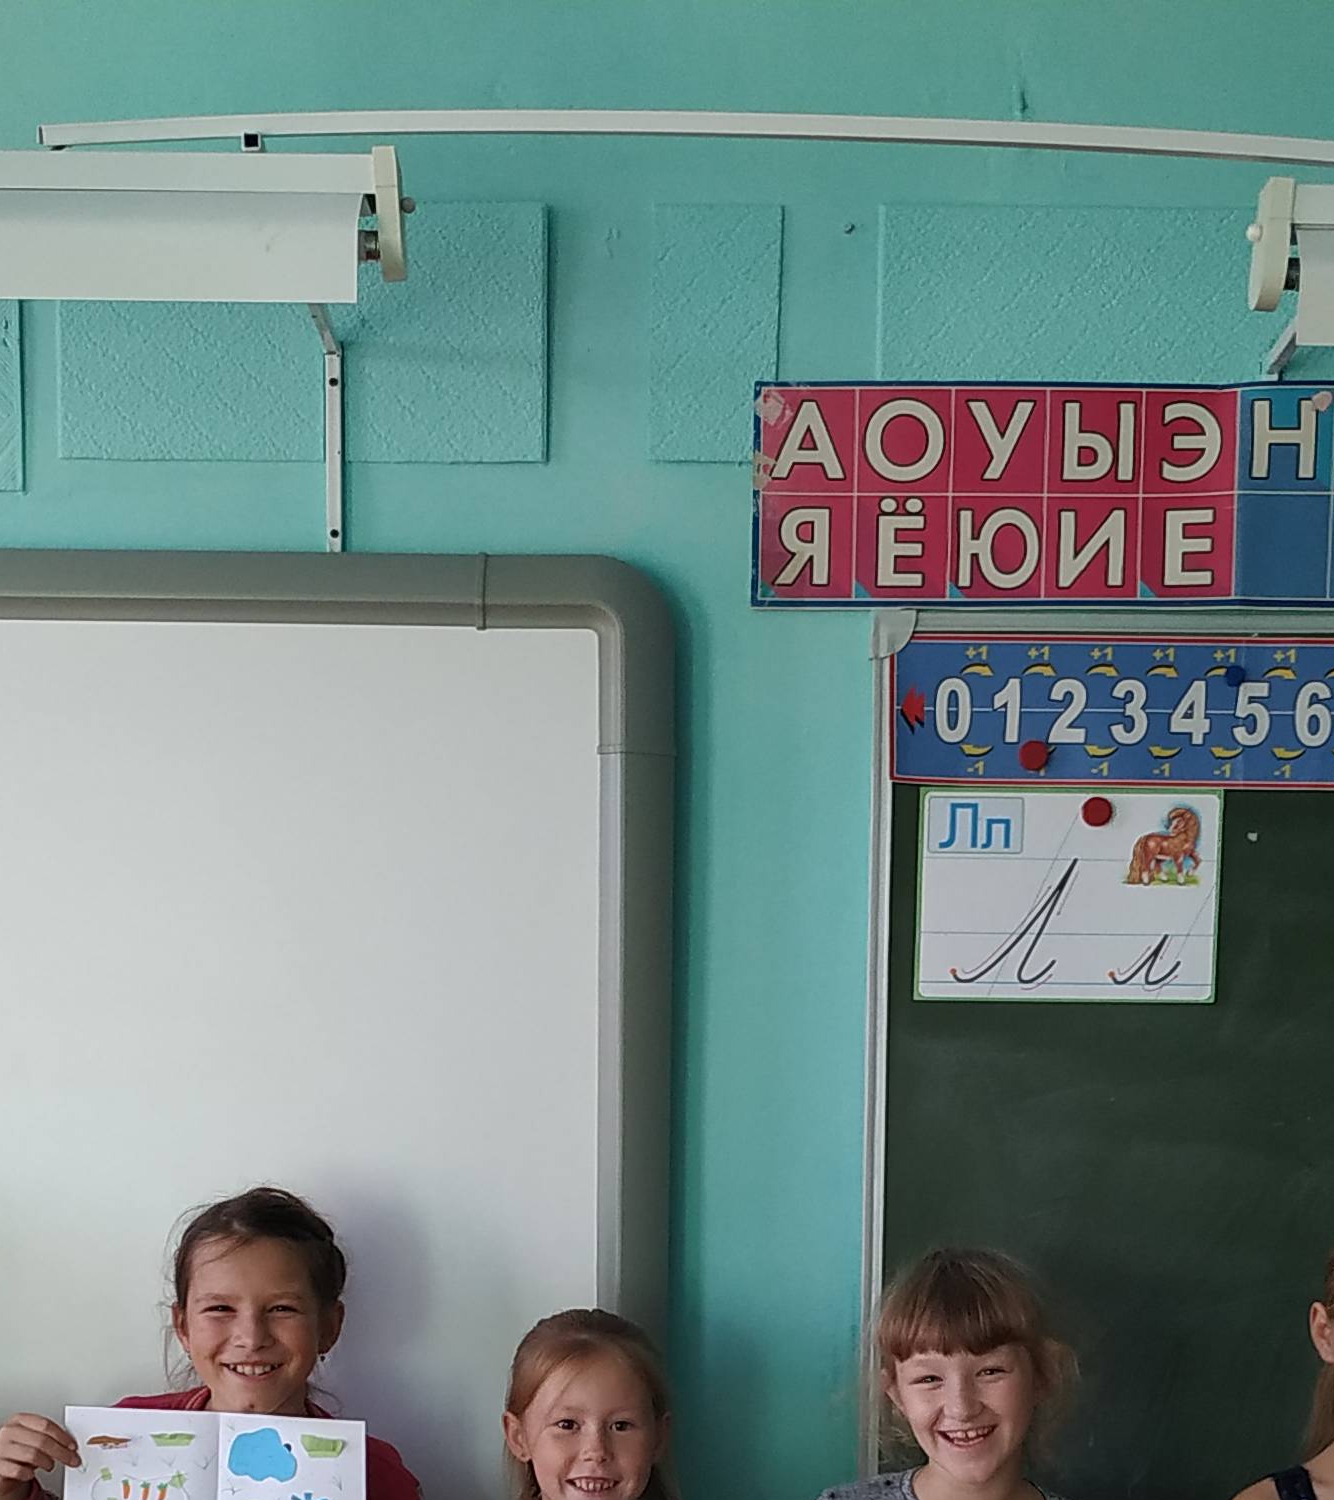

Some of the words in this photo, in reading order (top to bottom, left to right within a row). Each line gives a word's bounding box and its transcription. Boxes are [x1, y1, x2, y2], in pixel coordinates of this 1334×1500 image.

[771, 400, 846, 481] А
[865, 397, 945, 483] О
[967, 400, 1036, 481] У
[1064, 400, 1135, 482] Ы
[1160, 401, 1223, 483] Э
[1250, 399, 1317, 480] Н
[773, 506, 832, 587] Я
[876, 496, 927, 588] Ё
[958, 506, 1043, 589] Ю
[1058, 507, 1127, 588] И
[1162, 508, 1216, 587] Е
[965, 646, 988, 661] +1
[1027, 646, 1051, 661] +1
[1090, 646, 1114, 661] +1
[1152, 647, 1176, 662] +1
[1213, 648, 1237, 663] +1
[1274, 648, 1297, 663] +1
[935, 676, 972, 744] 0
[993, 677, 1022, 744] 1
[1048, 677, 1088, 744] 2
[1109, 678, 1148, 745] 3
[1170, 680, 1211, 746] 4
[1232, 681, 1270, 747] 5
[1295, 680, 1333, 747] 6
[967, 761, 985, 776] -1
[1090, 761, 1109, 777] -1
[1152, 762, 1171, 778] -1
[1213, 763, 1232, 778] -1
[1273, 763, 1292, 779] -1
[937, 801, 1012, 851] Лл
